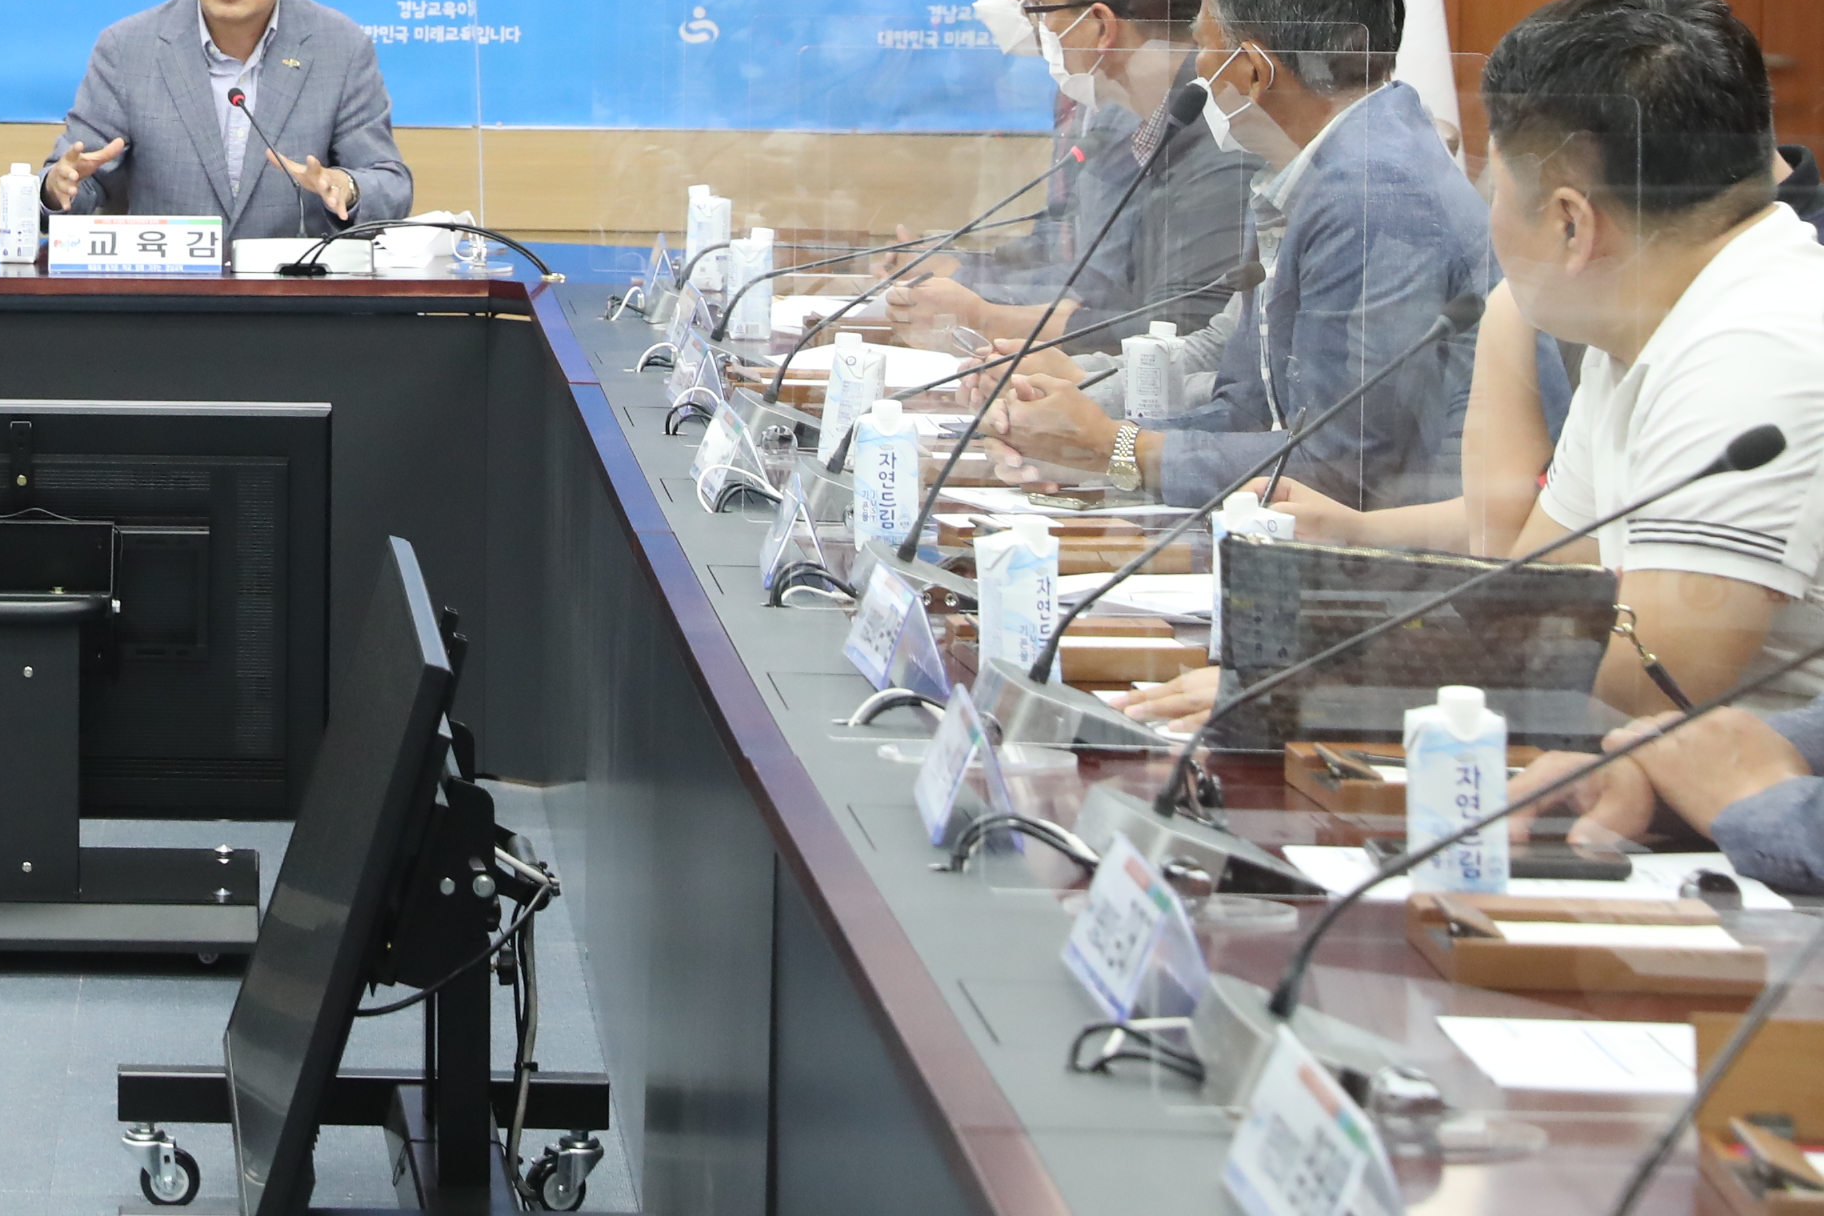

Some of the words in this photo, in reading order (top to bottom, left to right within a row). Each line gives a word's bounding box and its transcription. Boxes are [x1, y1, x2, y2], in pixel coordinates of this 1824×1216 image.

[396, 0, 477, 19] 경남교육이
[926, 4, 974, 24] 경남교
[360, 24, 410, 43] 한민국
[876, 29, 939, 49] 대한민국
[878, 451, 897, 530] 자연드림
[1036, 576, 1052, 650] 자연드
